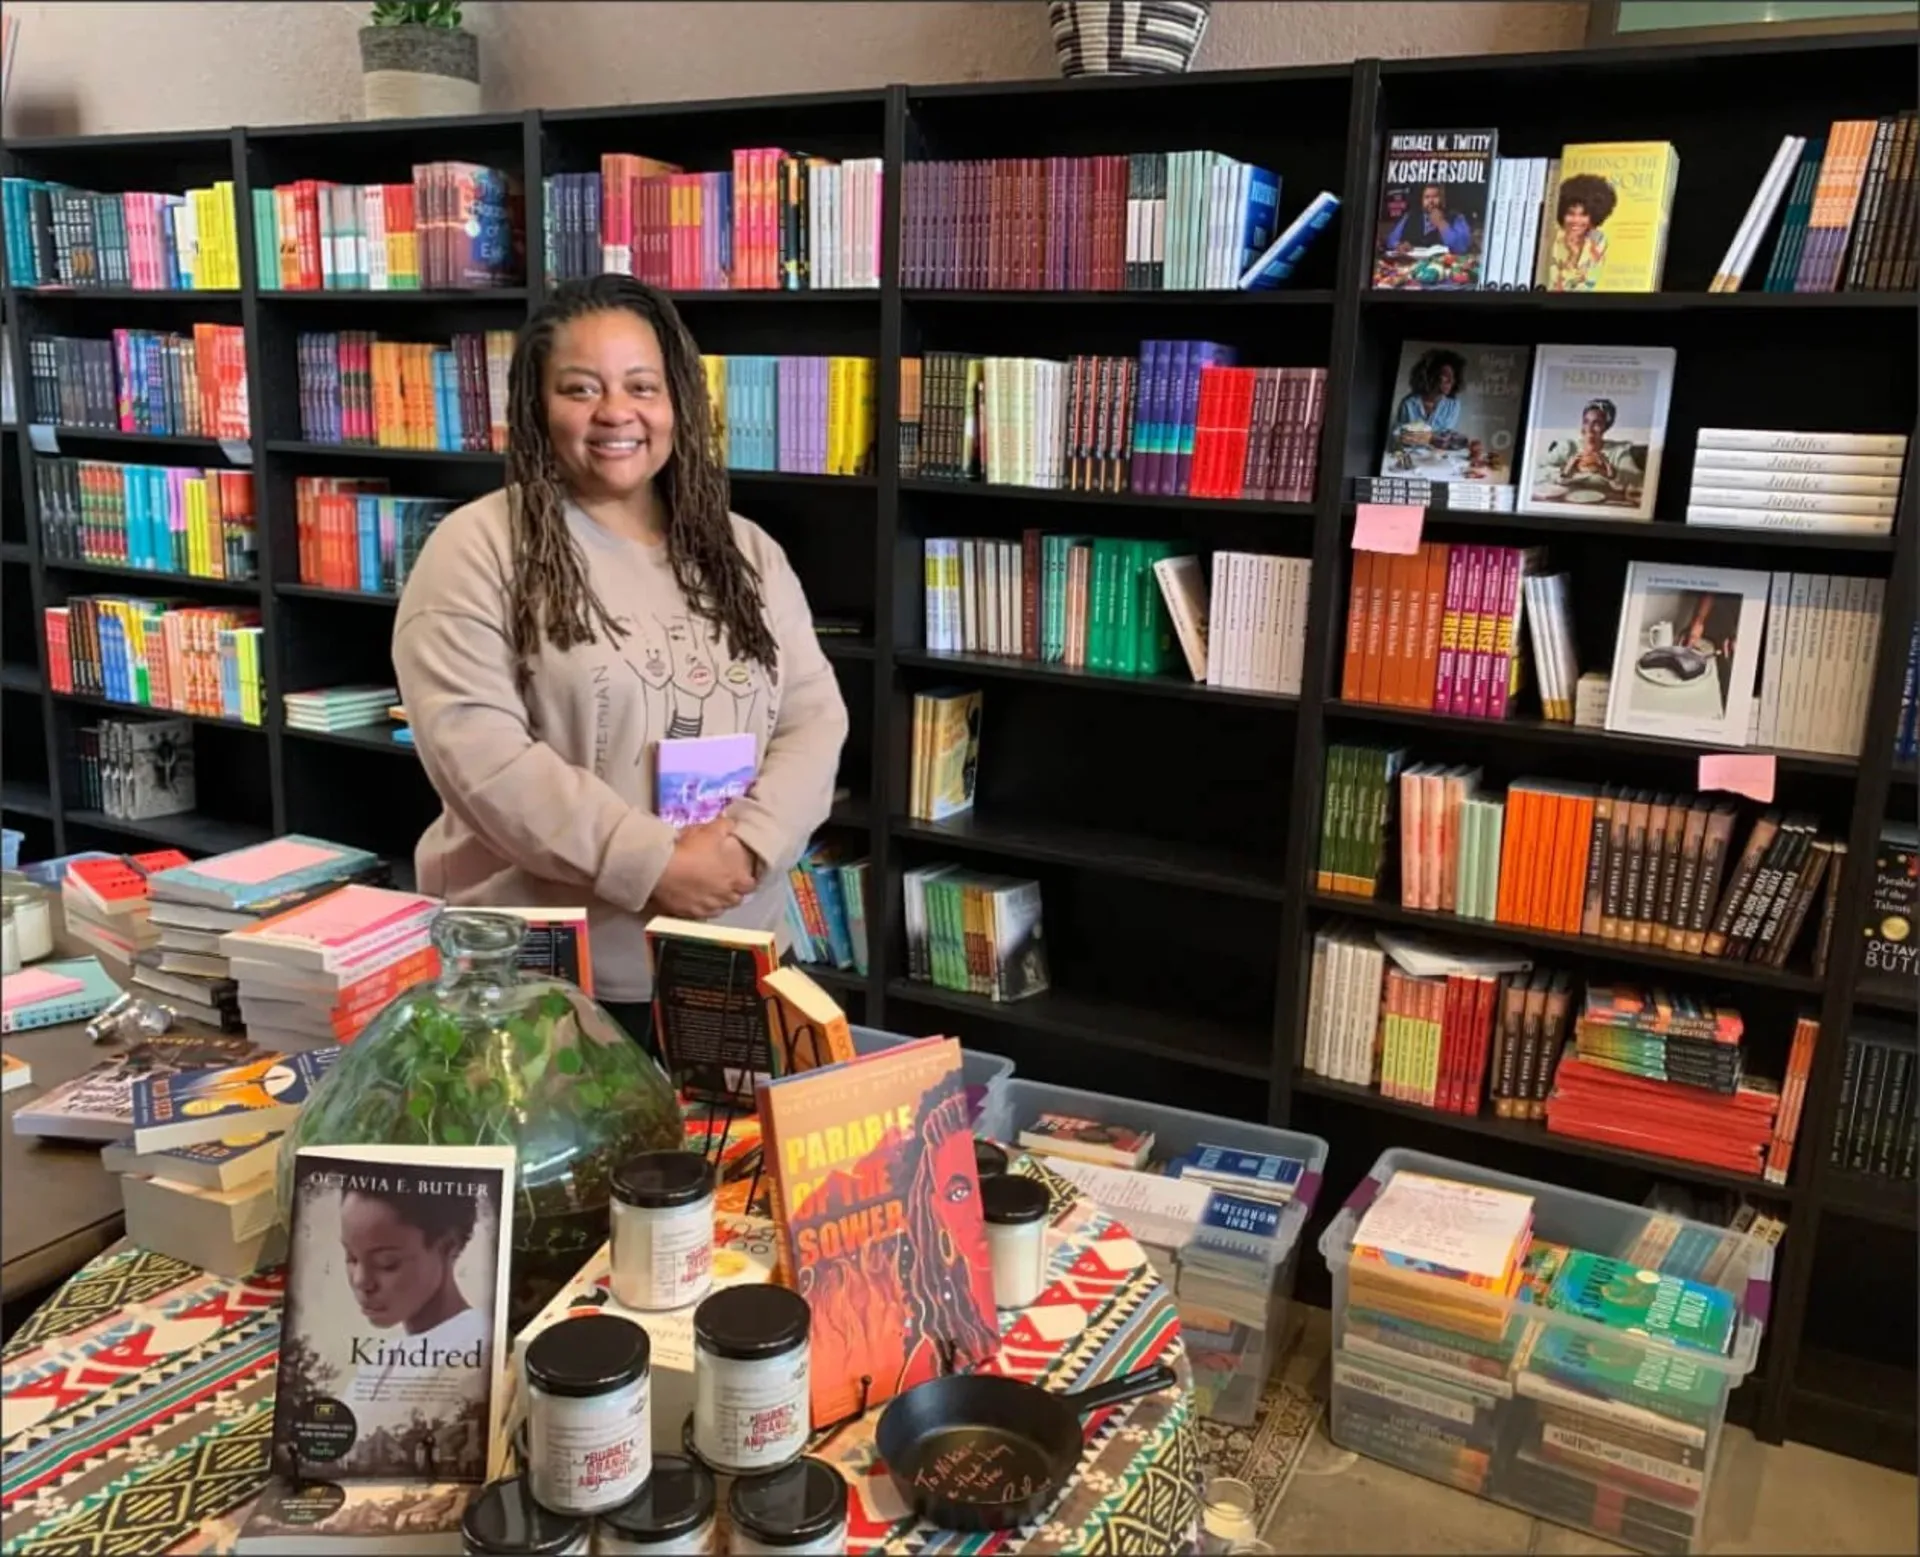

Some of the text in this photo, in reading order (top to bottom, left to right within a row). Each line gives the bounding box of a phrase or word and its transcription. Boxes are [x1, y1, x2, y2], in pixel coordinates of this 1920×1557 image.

[1391, 134, 1491, 151] MICHAEL W. TWITTY
[1387, 159, 1486, 184] KOSHERSOUL
[1877, 875, 1917, 889] Parable
[786, 1103, 914, 1175] PARABLE
[310, 1171, 389, 1192] OCTAVIA
[418, 1180, 489, 1197] BUTLER
[798, 1199, 905, 1268] SOWER
[350, 1337, 482, 1368] Kindred
